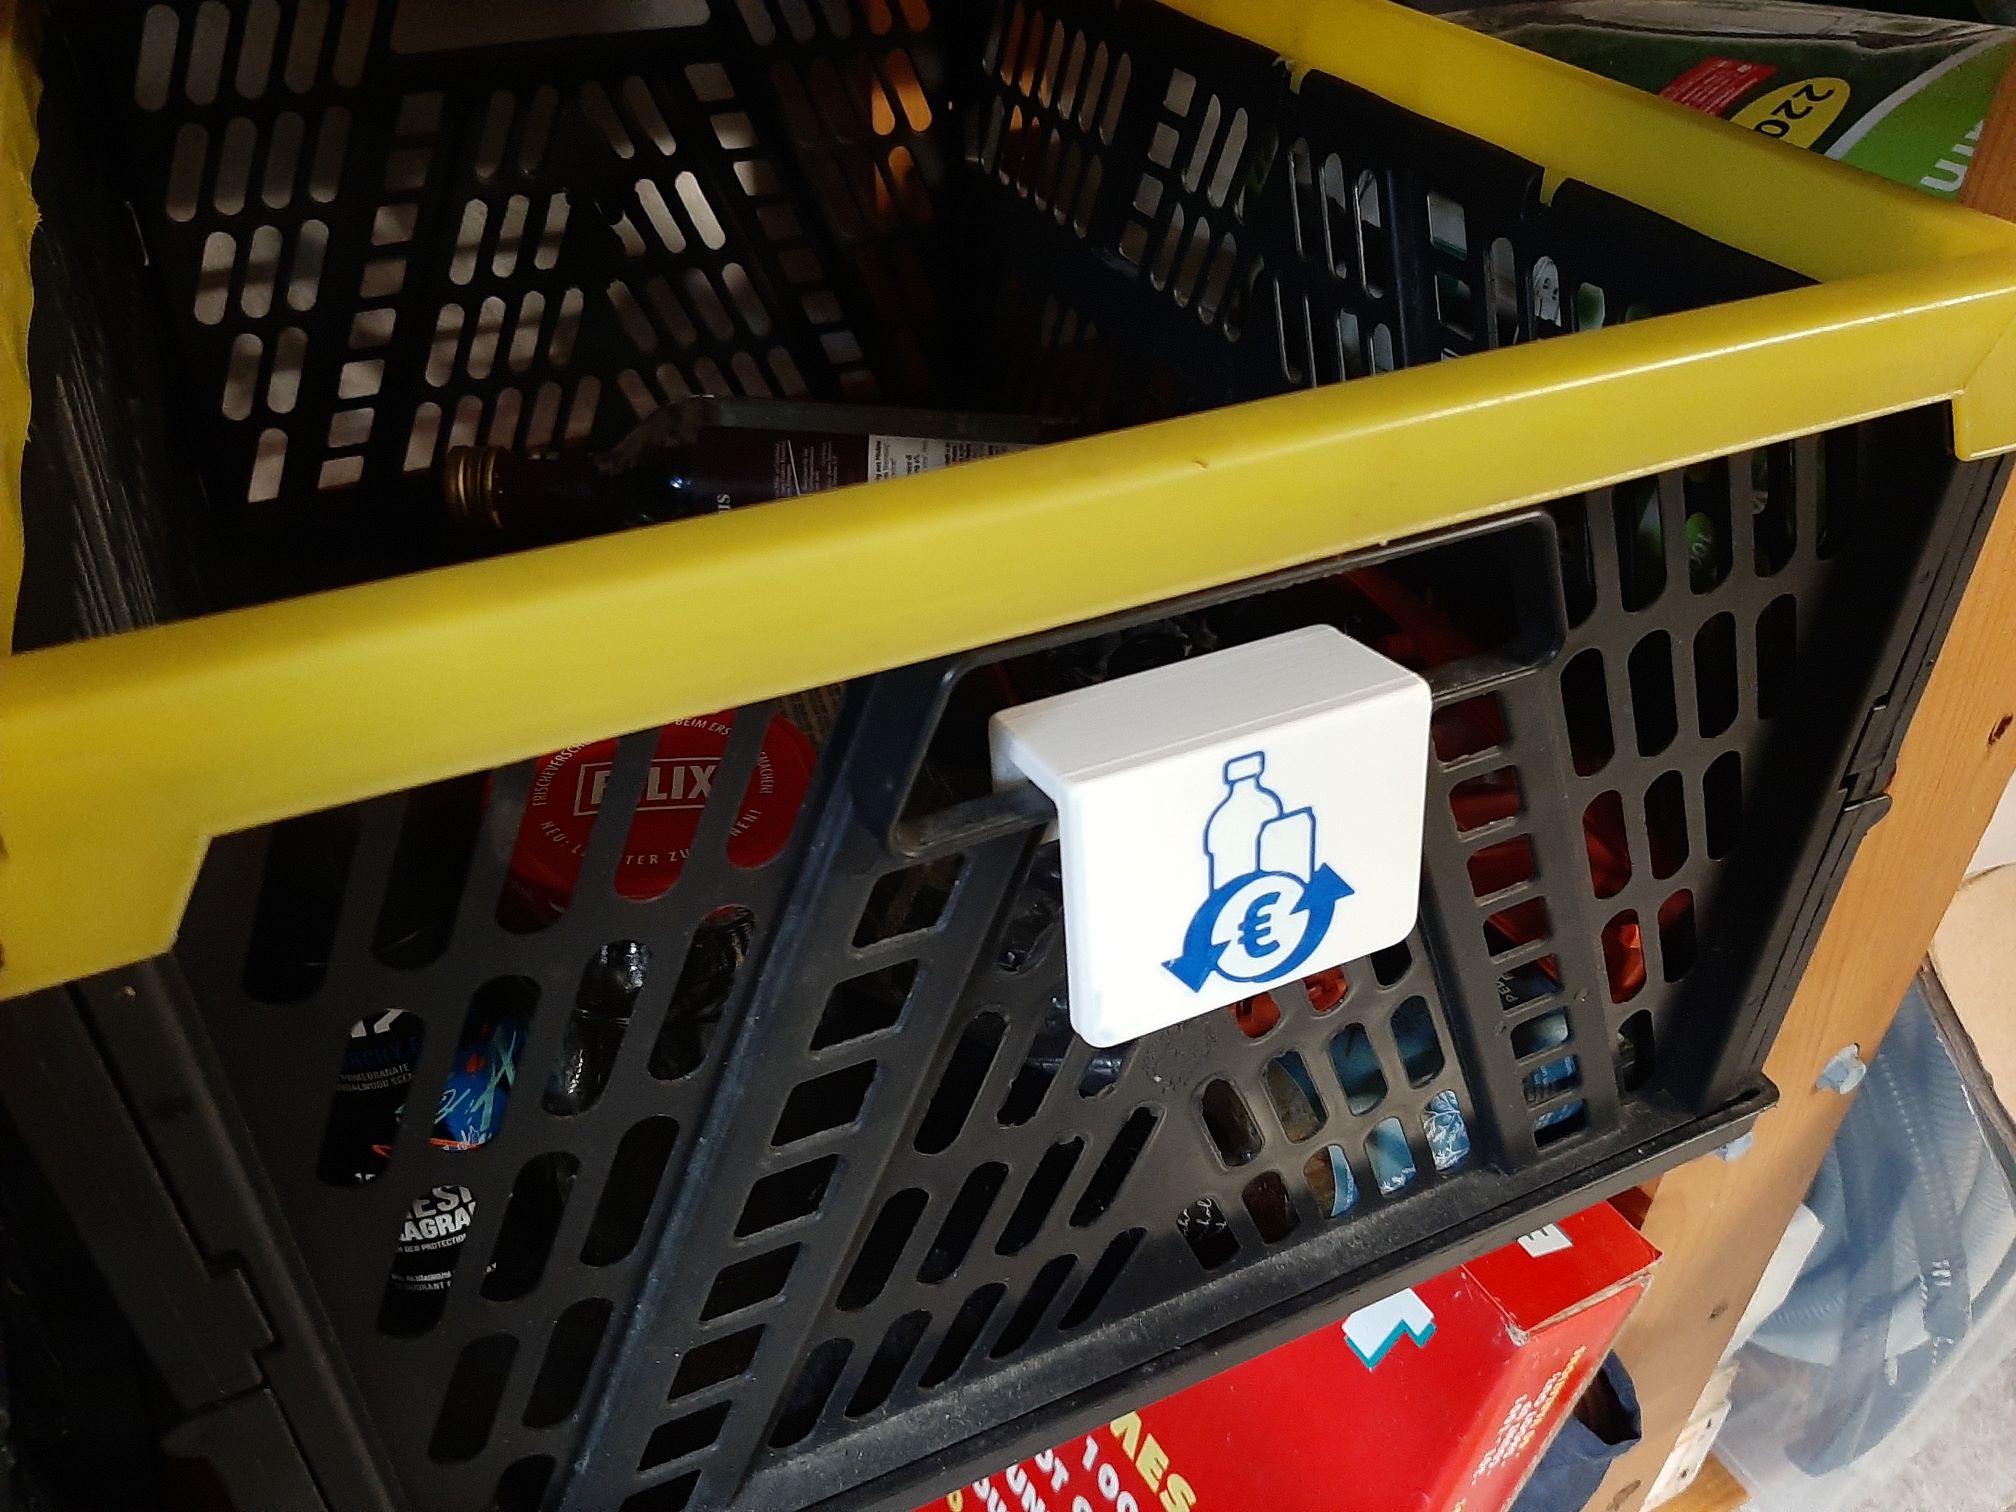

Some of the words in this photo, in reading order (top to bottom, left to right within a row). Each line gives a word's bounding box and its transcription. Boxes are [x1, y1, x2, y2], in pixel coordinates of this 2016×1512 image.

[1753, 83, 1834, 139] 220
[708, 722, 732, 736] ERS
[590, 764, 719, 805] FLIX
